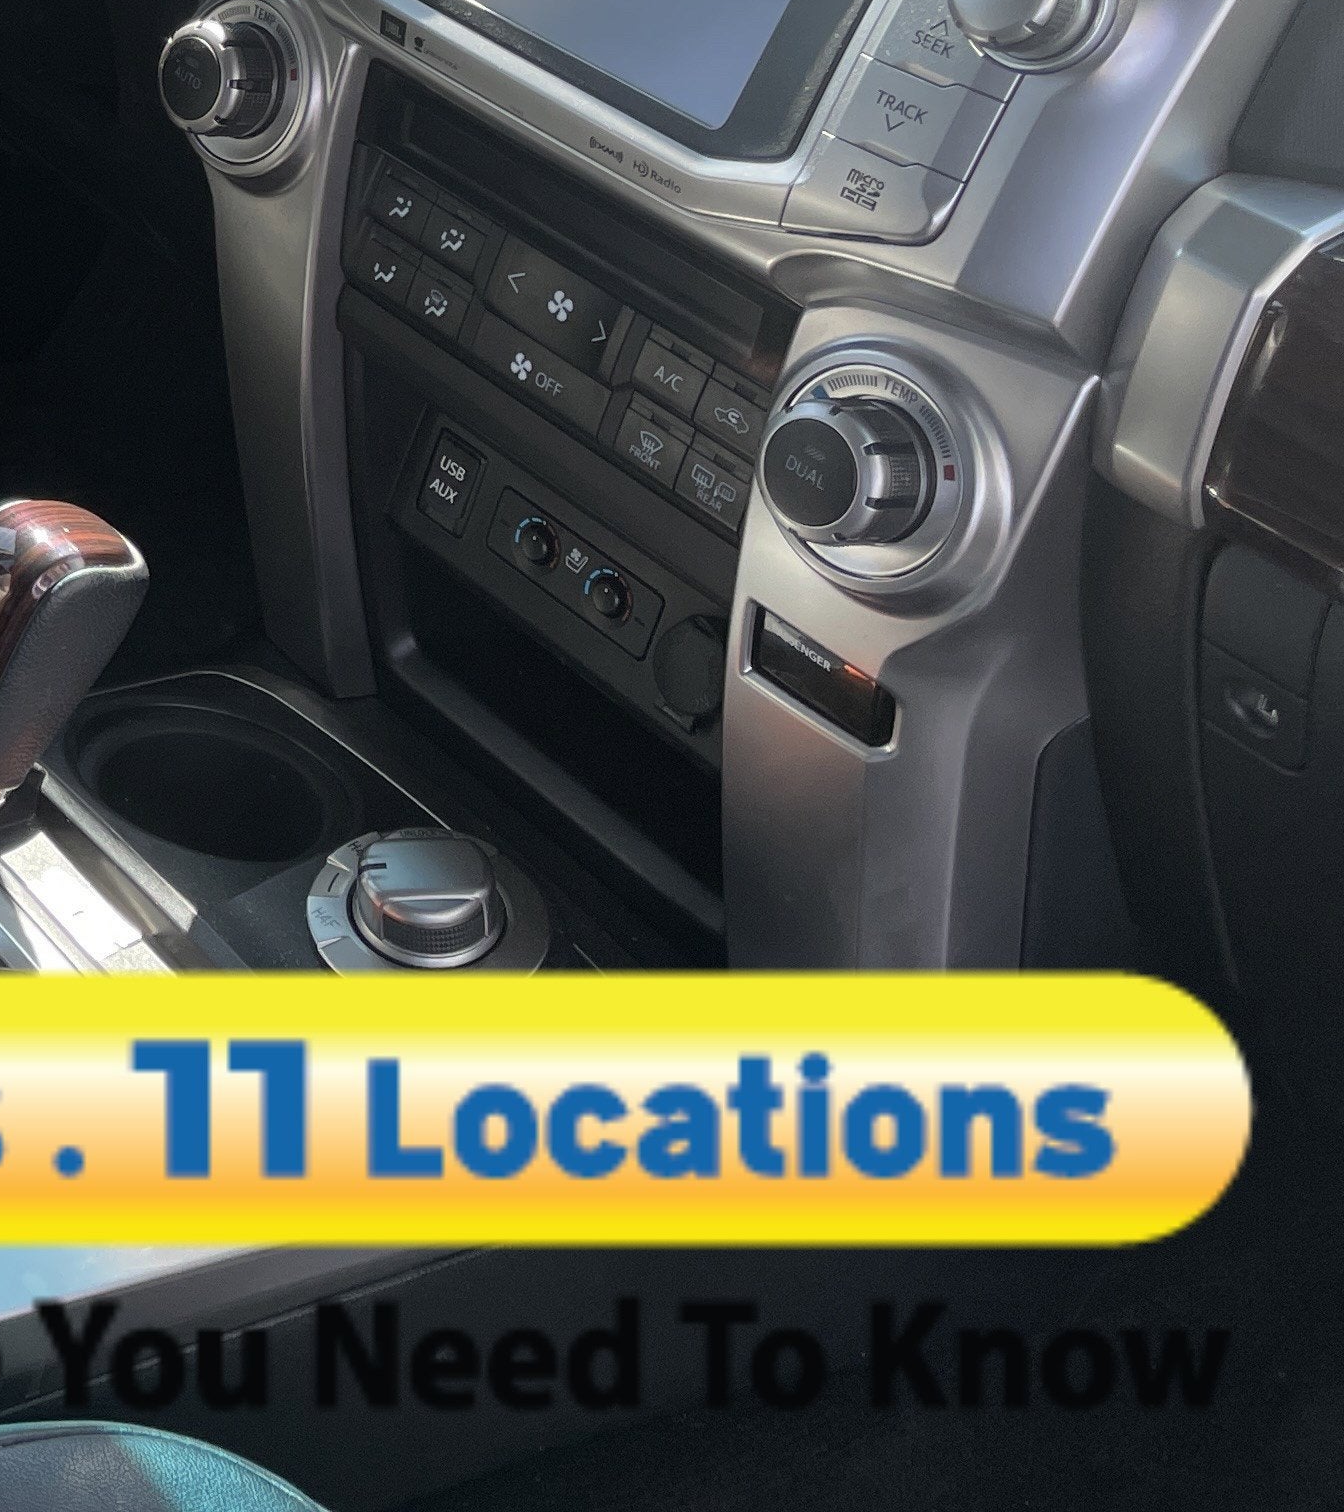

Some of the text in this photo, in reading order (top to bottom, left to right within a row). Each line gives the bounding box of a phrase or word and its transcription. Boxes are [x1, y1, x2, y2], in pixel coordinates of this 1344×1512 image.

[254, 4, 279, 25] TEMP
[912, 30, 956, 59] SEEK
[175, 68, 202, 89] AUTO
[876, 89, 928, 124] TRACK
[650, 170, 682, 194] Radio
[846, 168, 885, 191] micro
[535, 372, 563, 397] OFF
[653, 365, 684, 393] A/C
[883, 374, 918, 404] TEMP
[440, 455, 466, 481] USB
[628, 444, 661, 471] FRONT
[785, 454, 824, 491] DUAL
[429, 478, 459, 504] AUX
[696, 488, 723, 513] REAR
[311, 906, 341, 929] H4F
